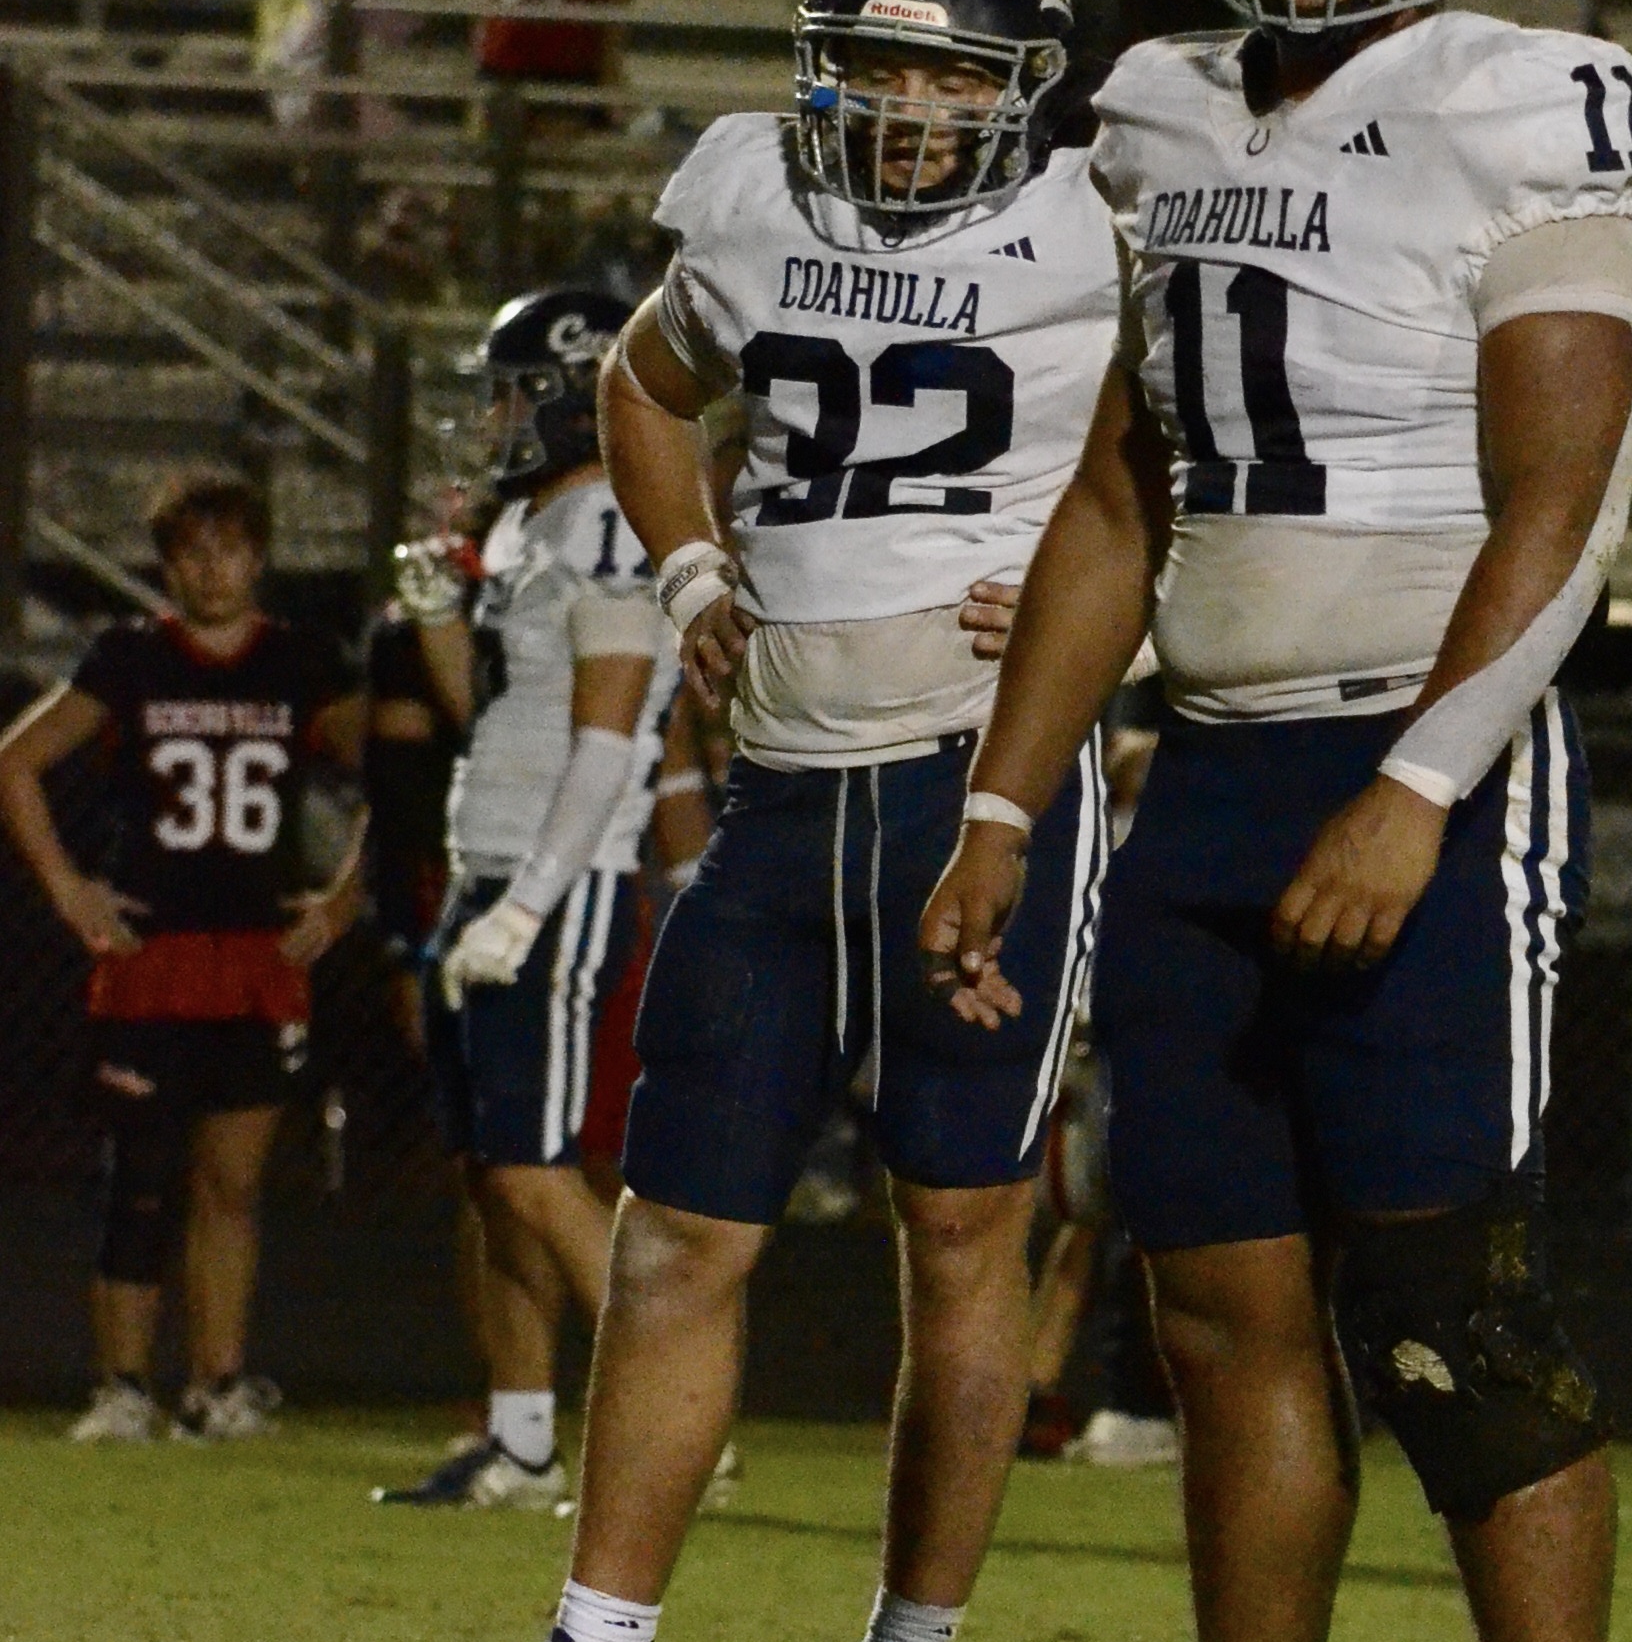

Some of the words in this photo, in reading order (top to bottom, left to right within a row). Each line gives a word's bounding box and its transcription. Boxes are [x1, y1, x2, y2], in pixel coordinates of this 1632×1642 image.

[1145, 187, 1331, 253] COAHULLA
[778, 256, 981, 335] COAHULLA
[739, 330, 1015, 527] 32
[1164, 259, 1327, 516] 11
[150, 738, 290, 853] 36
